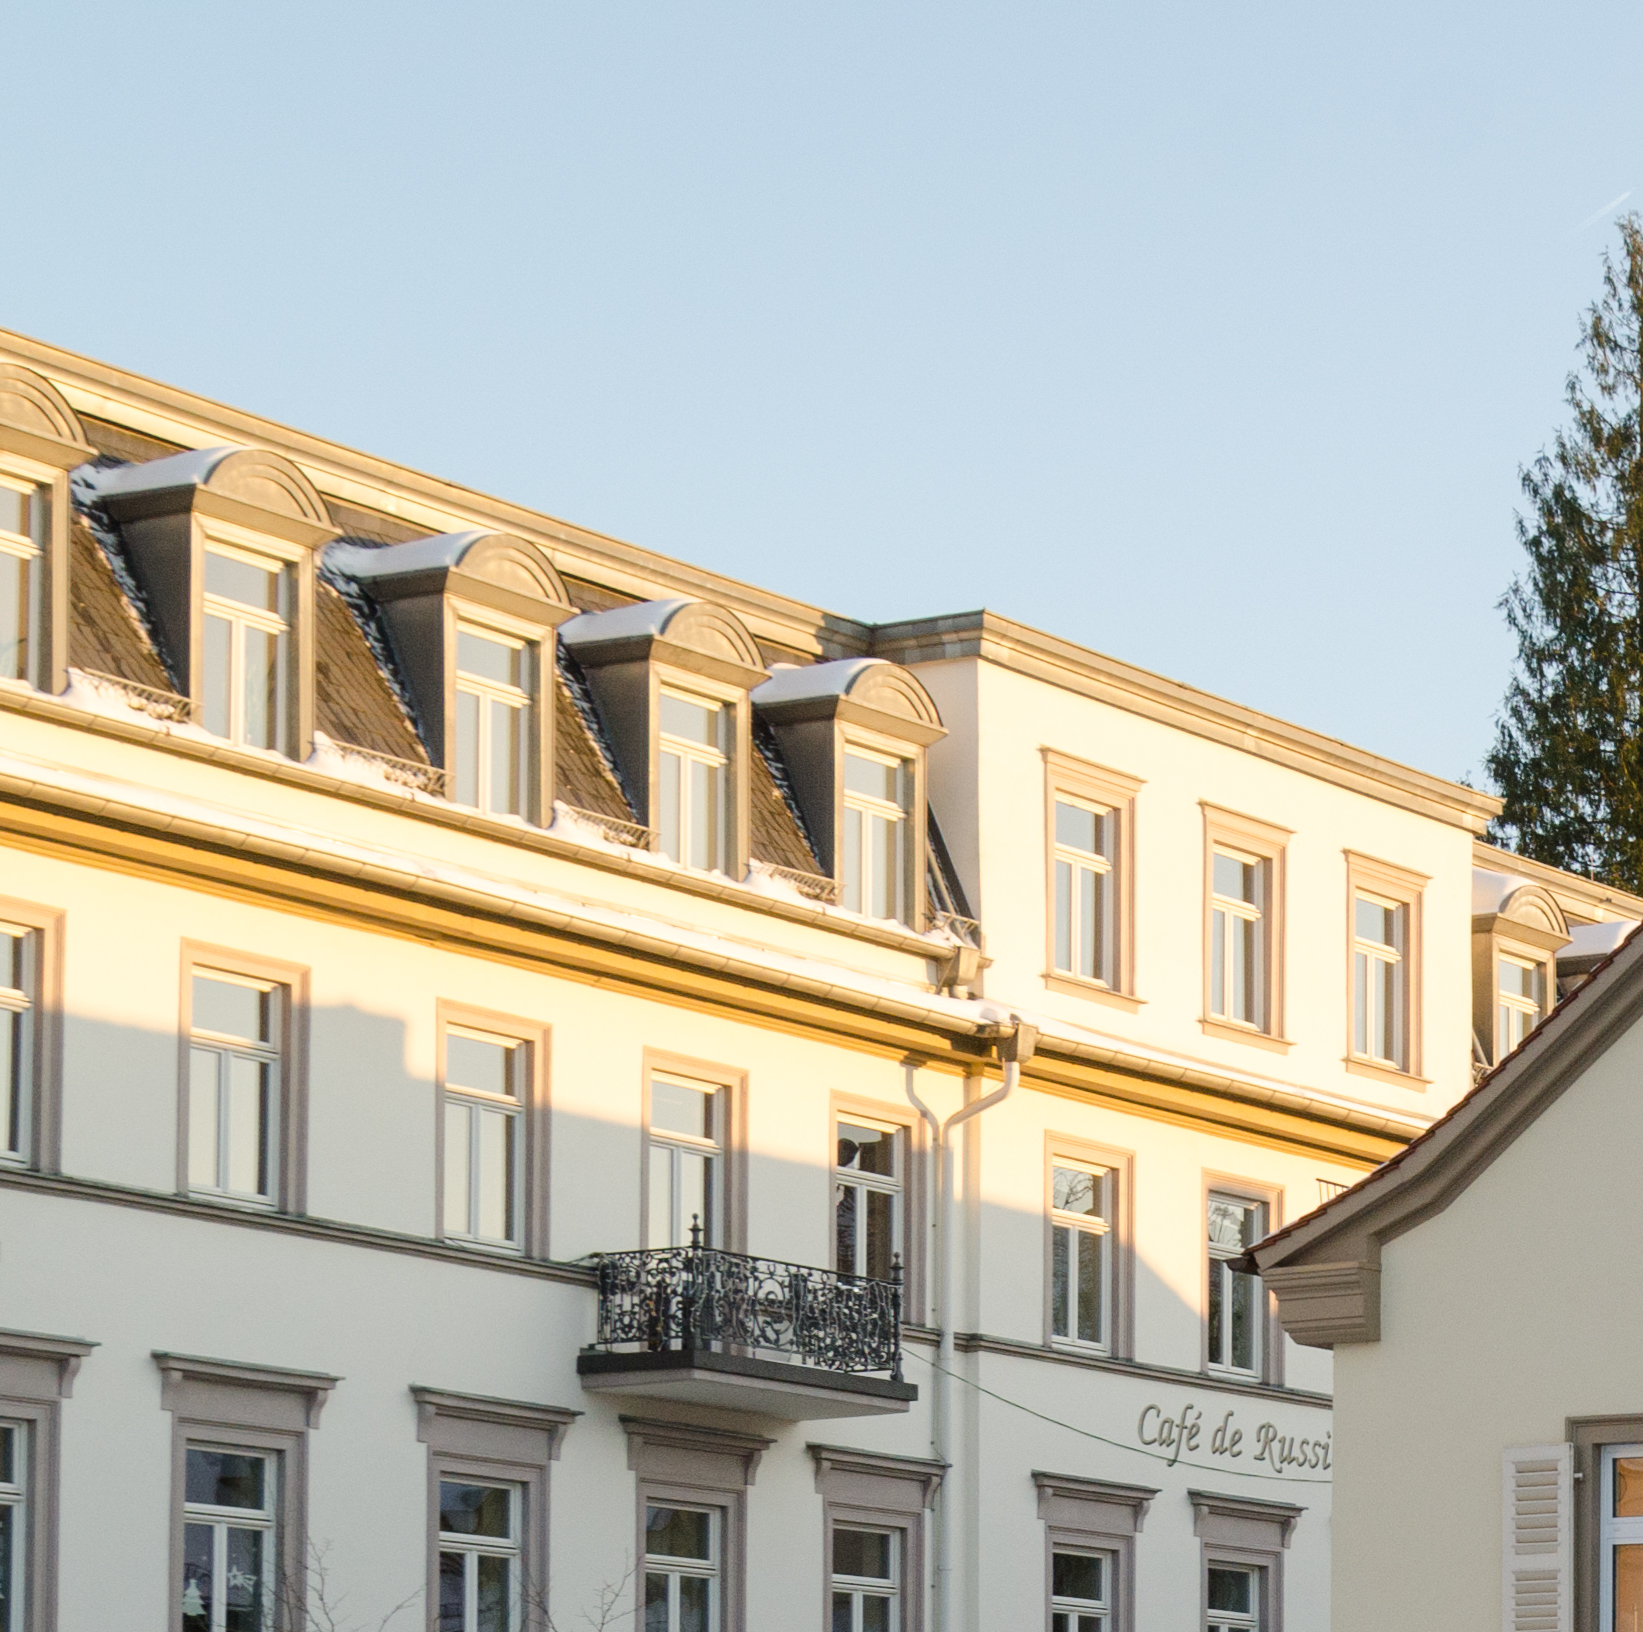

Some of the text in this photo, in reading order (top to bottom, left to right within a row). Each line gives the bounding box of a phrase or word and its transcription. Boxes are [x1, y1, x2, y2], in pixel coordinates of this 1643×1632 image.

[1137, 1403, 1333, 1473] Café de Russi
